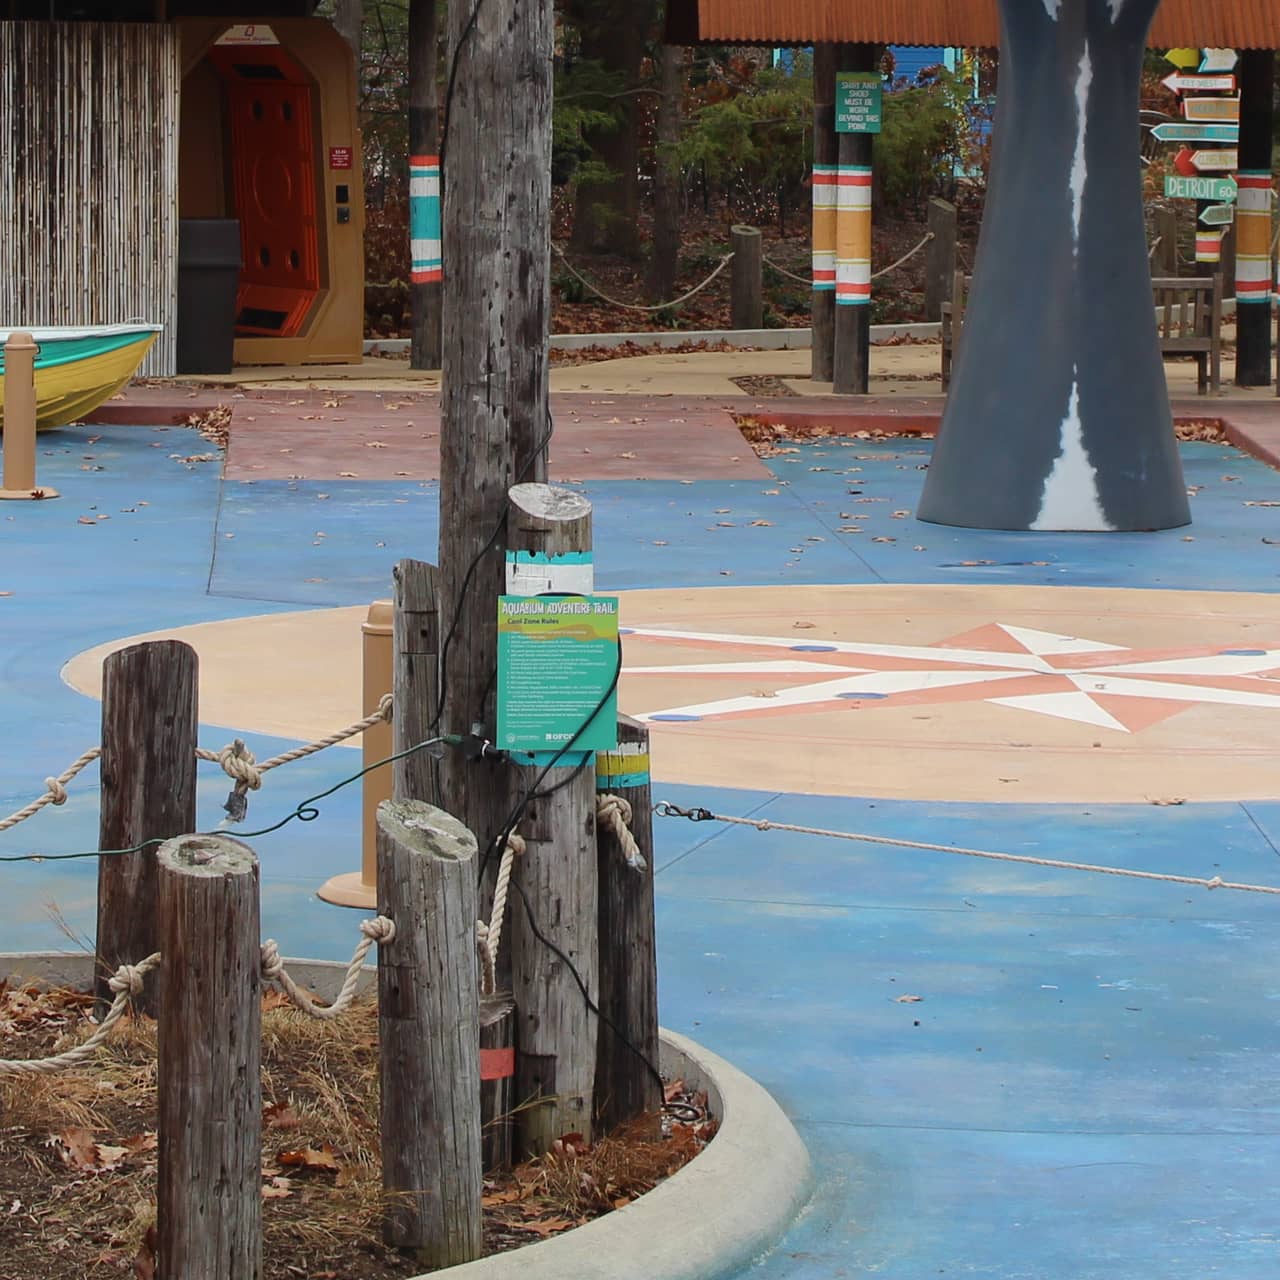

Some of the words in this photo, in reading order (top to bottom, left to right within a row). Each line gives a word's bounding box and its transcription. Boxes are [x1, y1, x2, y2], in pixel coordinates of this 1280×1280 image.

[1168, 177, 1216, 198] DETROIT
[502, 602, 545, 615] AQUARIUM
[547, 602, 591, 615] ADVENTURE
[592, 602, 616, 614] TRAIL
